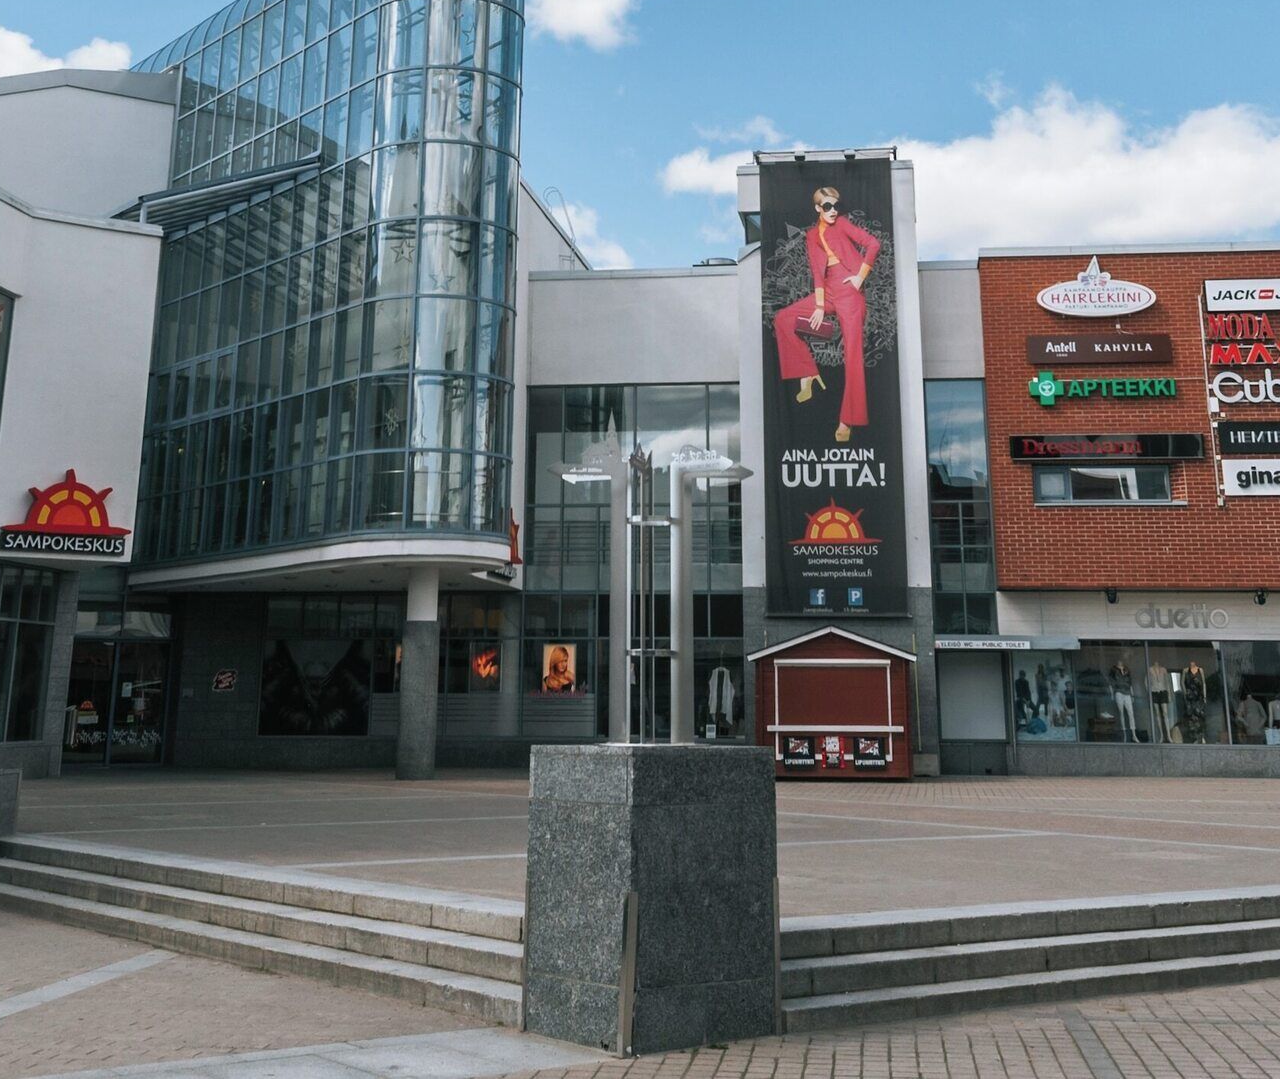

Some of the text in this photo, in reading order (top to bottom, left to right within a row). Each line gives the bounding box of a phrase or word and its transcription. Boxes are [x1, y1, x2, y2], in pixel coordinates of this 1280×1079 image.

[1050, 291, 1142, 304] HAIRLEKIINI
[1212, 289, 1256, 301] JACK
[1207, 312, 1276, 340] MODA
[1045, 341, 1153, 353] Antell KAHVILA
[1068, 377, 1177, 398] APTEEKKI
[782, 448, 874, 461] AINA JOTAIN
[1021, 438, 1144, 456] Dressmann
[781, 463, 886, 487] UUTTA!
[5, 534, 123, 553] SAMPOKESKUS
[793, 545, 879, 556] SAMPOKESKUS
[802, 568, 873, 578] www.sampokeskus.fi
[1135, 603, 1229, 629] duetto
